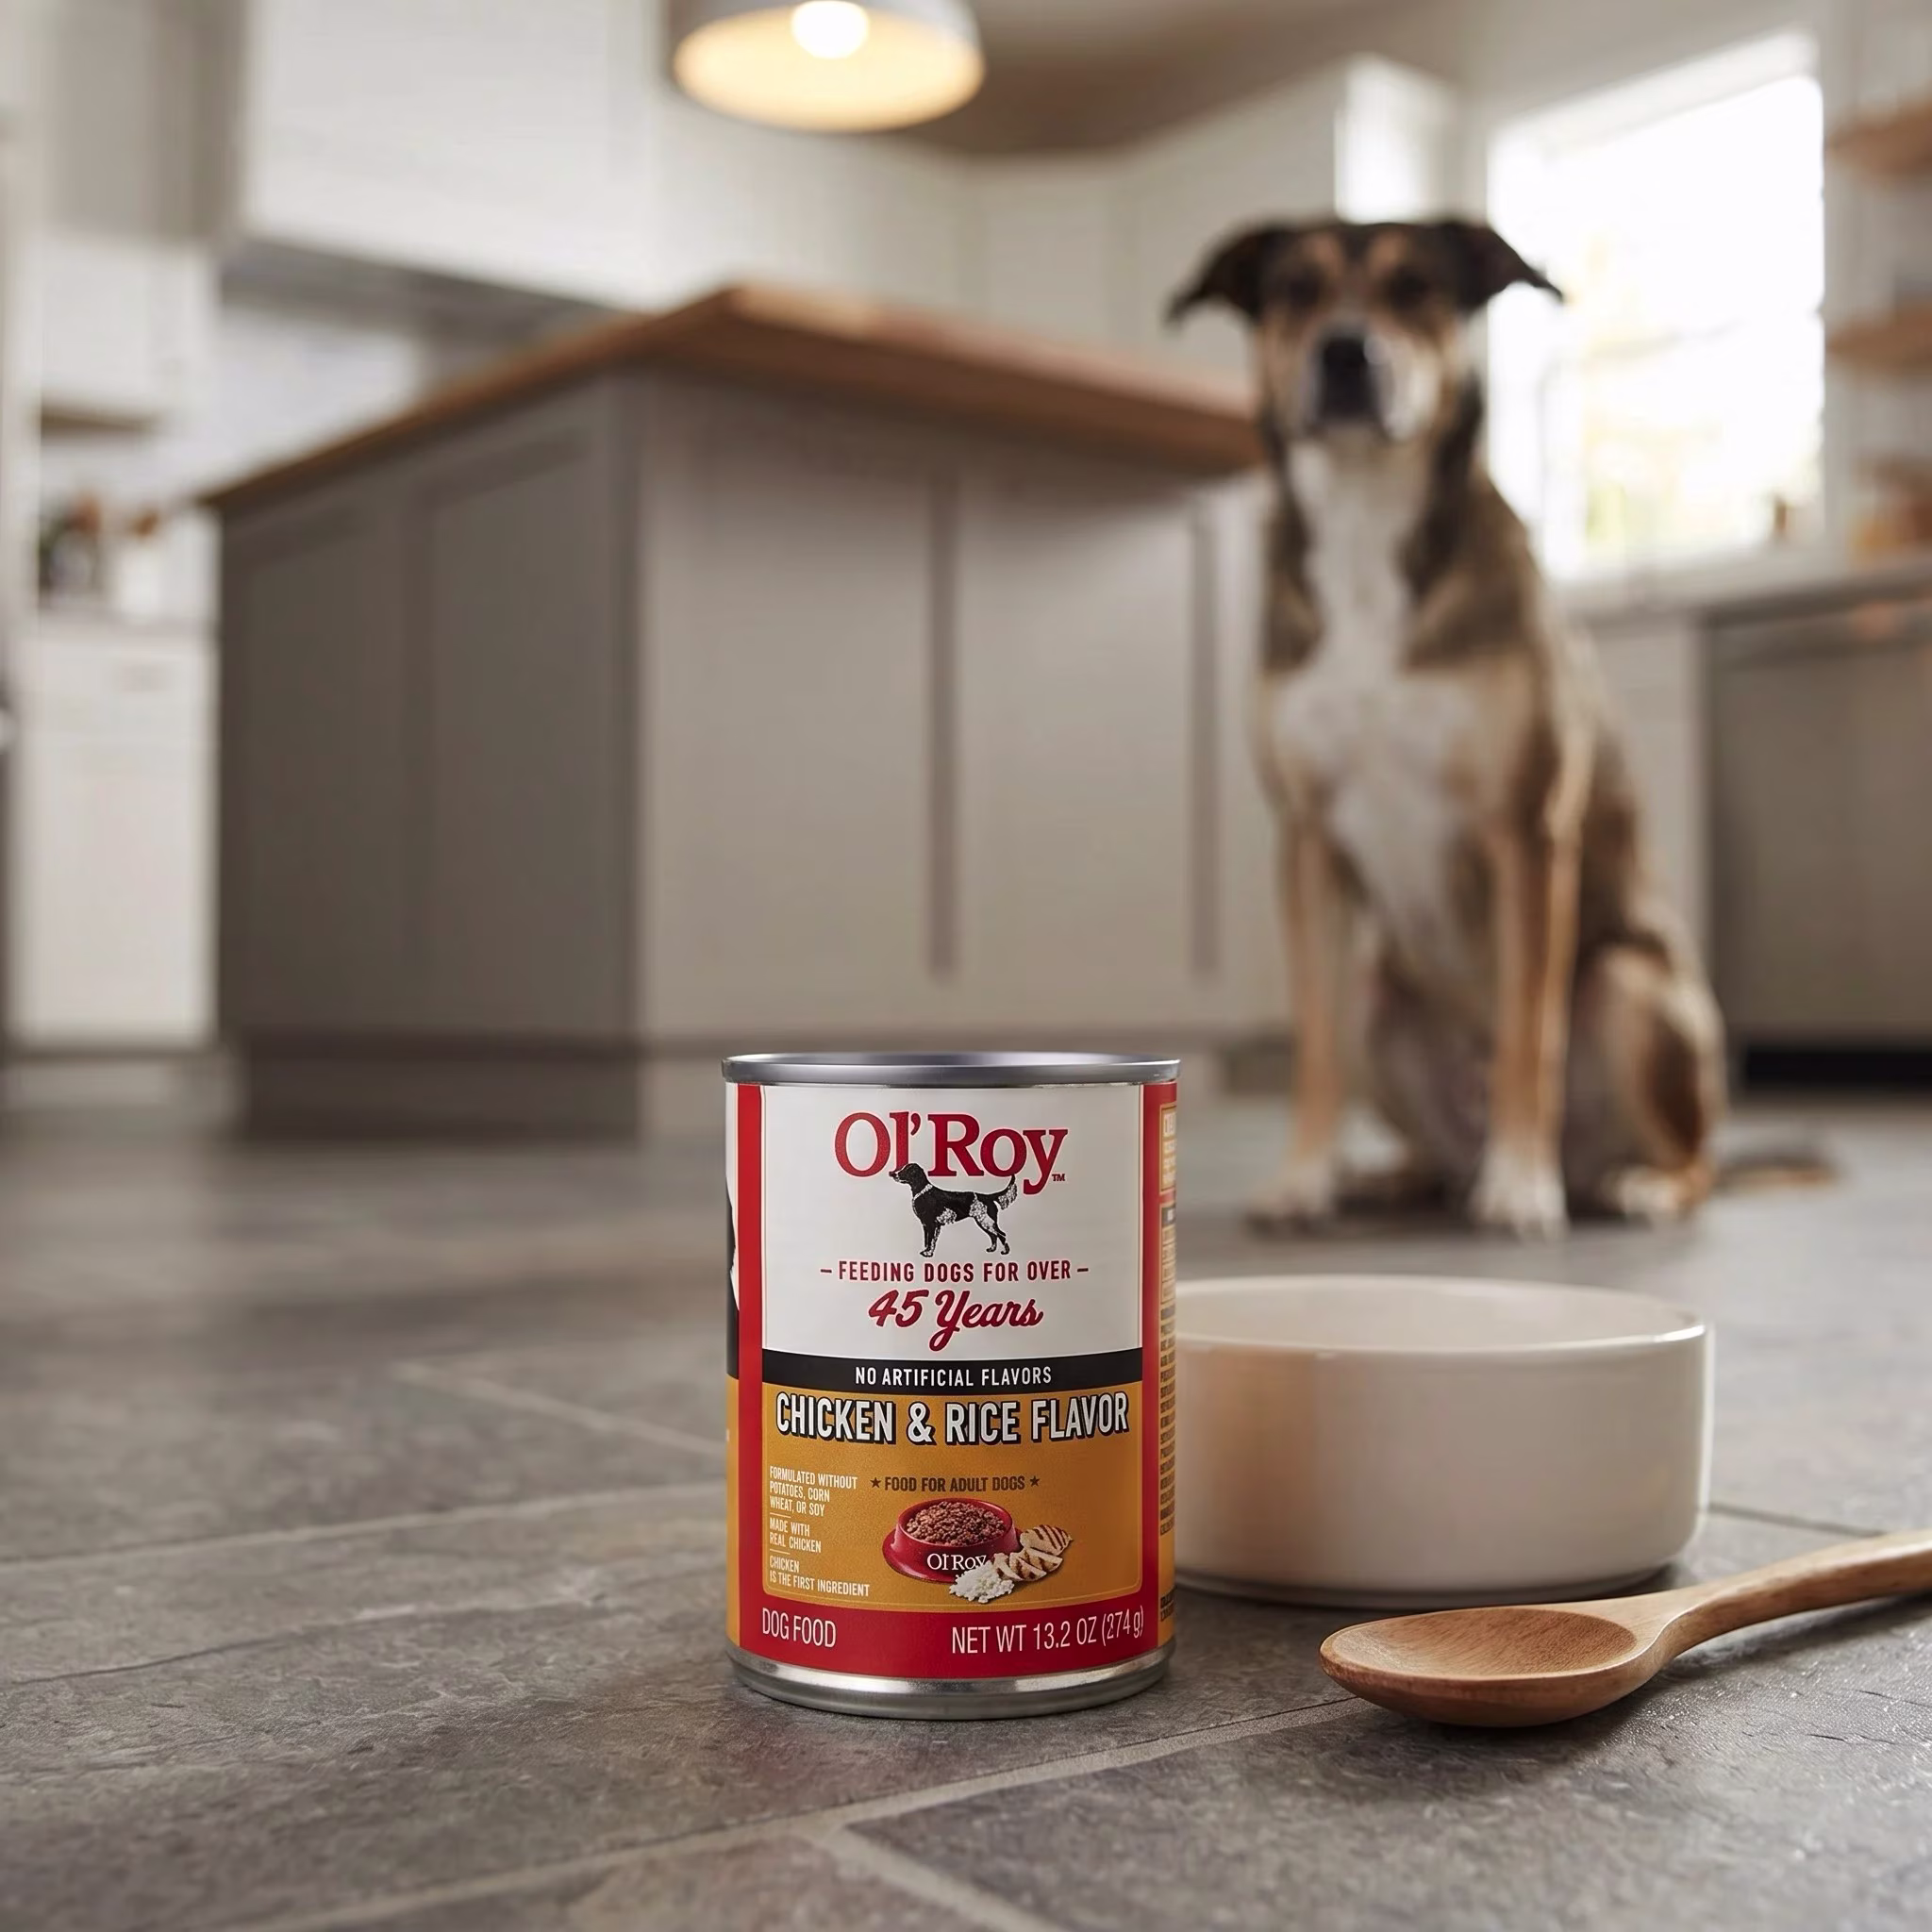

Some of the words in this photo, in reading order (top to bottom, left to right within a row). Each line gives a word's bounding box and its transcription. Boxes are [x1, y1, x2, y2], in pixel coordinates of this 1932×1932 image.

[839, 1260, 914, 1282] FEEDING
[924, 1262, 974, 1283] DOGS
[983, 1262, 1019, 1282] FOR
[1027, 1260, 1071, 1280] OVER
[868, 1289, 929, 1328] 45
[928, 1290, 1044, 1352] Years
[856, 1367, 876, 1385] NO
[882, 1368, 974, 1387] ARTIFICIAL
[981, 1367, 1052, 1386] FLAVORS
[775, 1391, 896, 1444] CHICKEN
[906, 1401, 936, 1445] &
[944, 1400, 1021, 1444] RICE
[1031, 1391, 1130, 1442] FLAVOR
[770, 1465, 816, 1486] FORMULATED
[818, 1473, 858, 1490] WITHOUT
[884, 1476, 917, 1491] FOOD
[921, 1476, 946, 1492] FOR
[949, 1476, 989, 1492] ADULT
[992, 1475, 1025, 1491] DOGS
[770, 1480, 807, 1501] POTATOES,
[808, 1487, 830, 1503] CORN
[770, 1495, 794, 1514] WHEAT,
[796, 1501, 807, 1514] OR
[808, 1503, 825, 1517] SOY
[770, 1517, 789, 1533] MADE
[791, 1522, 810, 1537] WITH
[770, 1532, 787, 1547] REAL
[789, 1536, 822, 1554] CHICKEN
[770, 1555, 800, 1574] CHICKEN
[770, 1570, 777, 1583] IS
[778, 1572, 791, 1587] THE
[792, 1576, 815, 1591] FIRST
[817, 1578, 870, 1597] INGREDIENT
[762, 1607, 790, 1641] DOG
[793, 1615, 837, 1648] FOOD
[952, 1625, 991, 1654] NET
[995, 1624, 1027, 1653] WT
[1033, 1620, 1071, 1650] 13.2
[1076, 1615, 1097, 1645] OZ
[1101, 1608, 1131, 1647] (274
